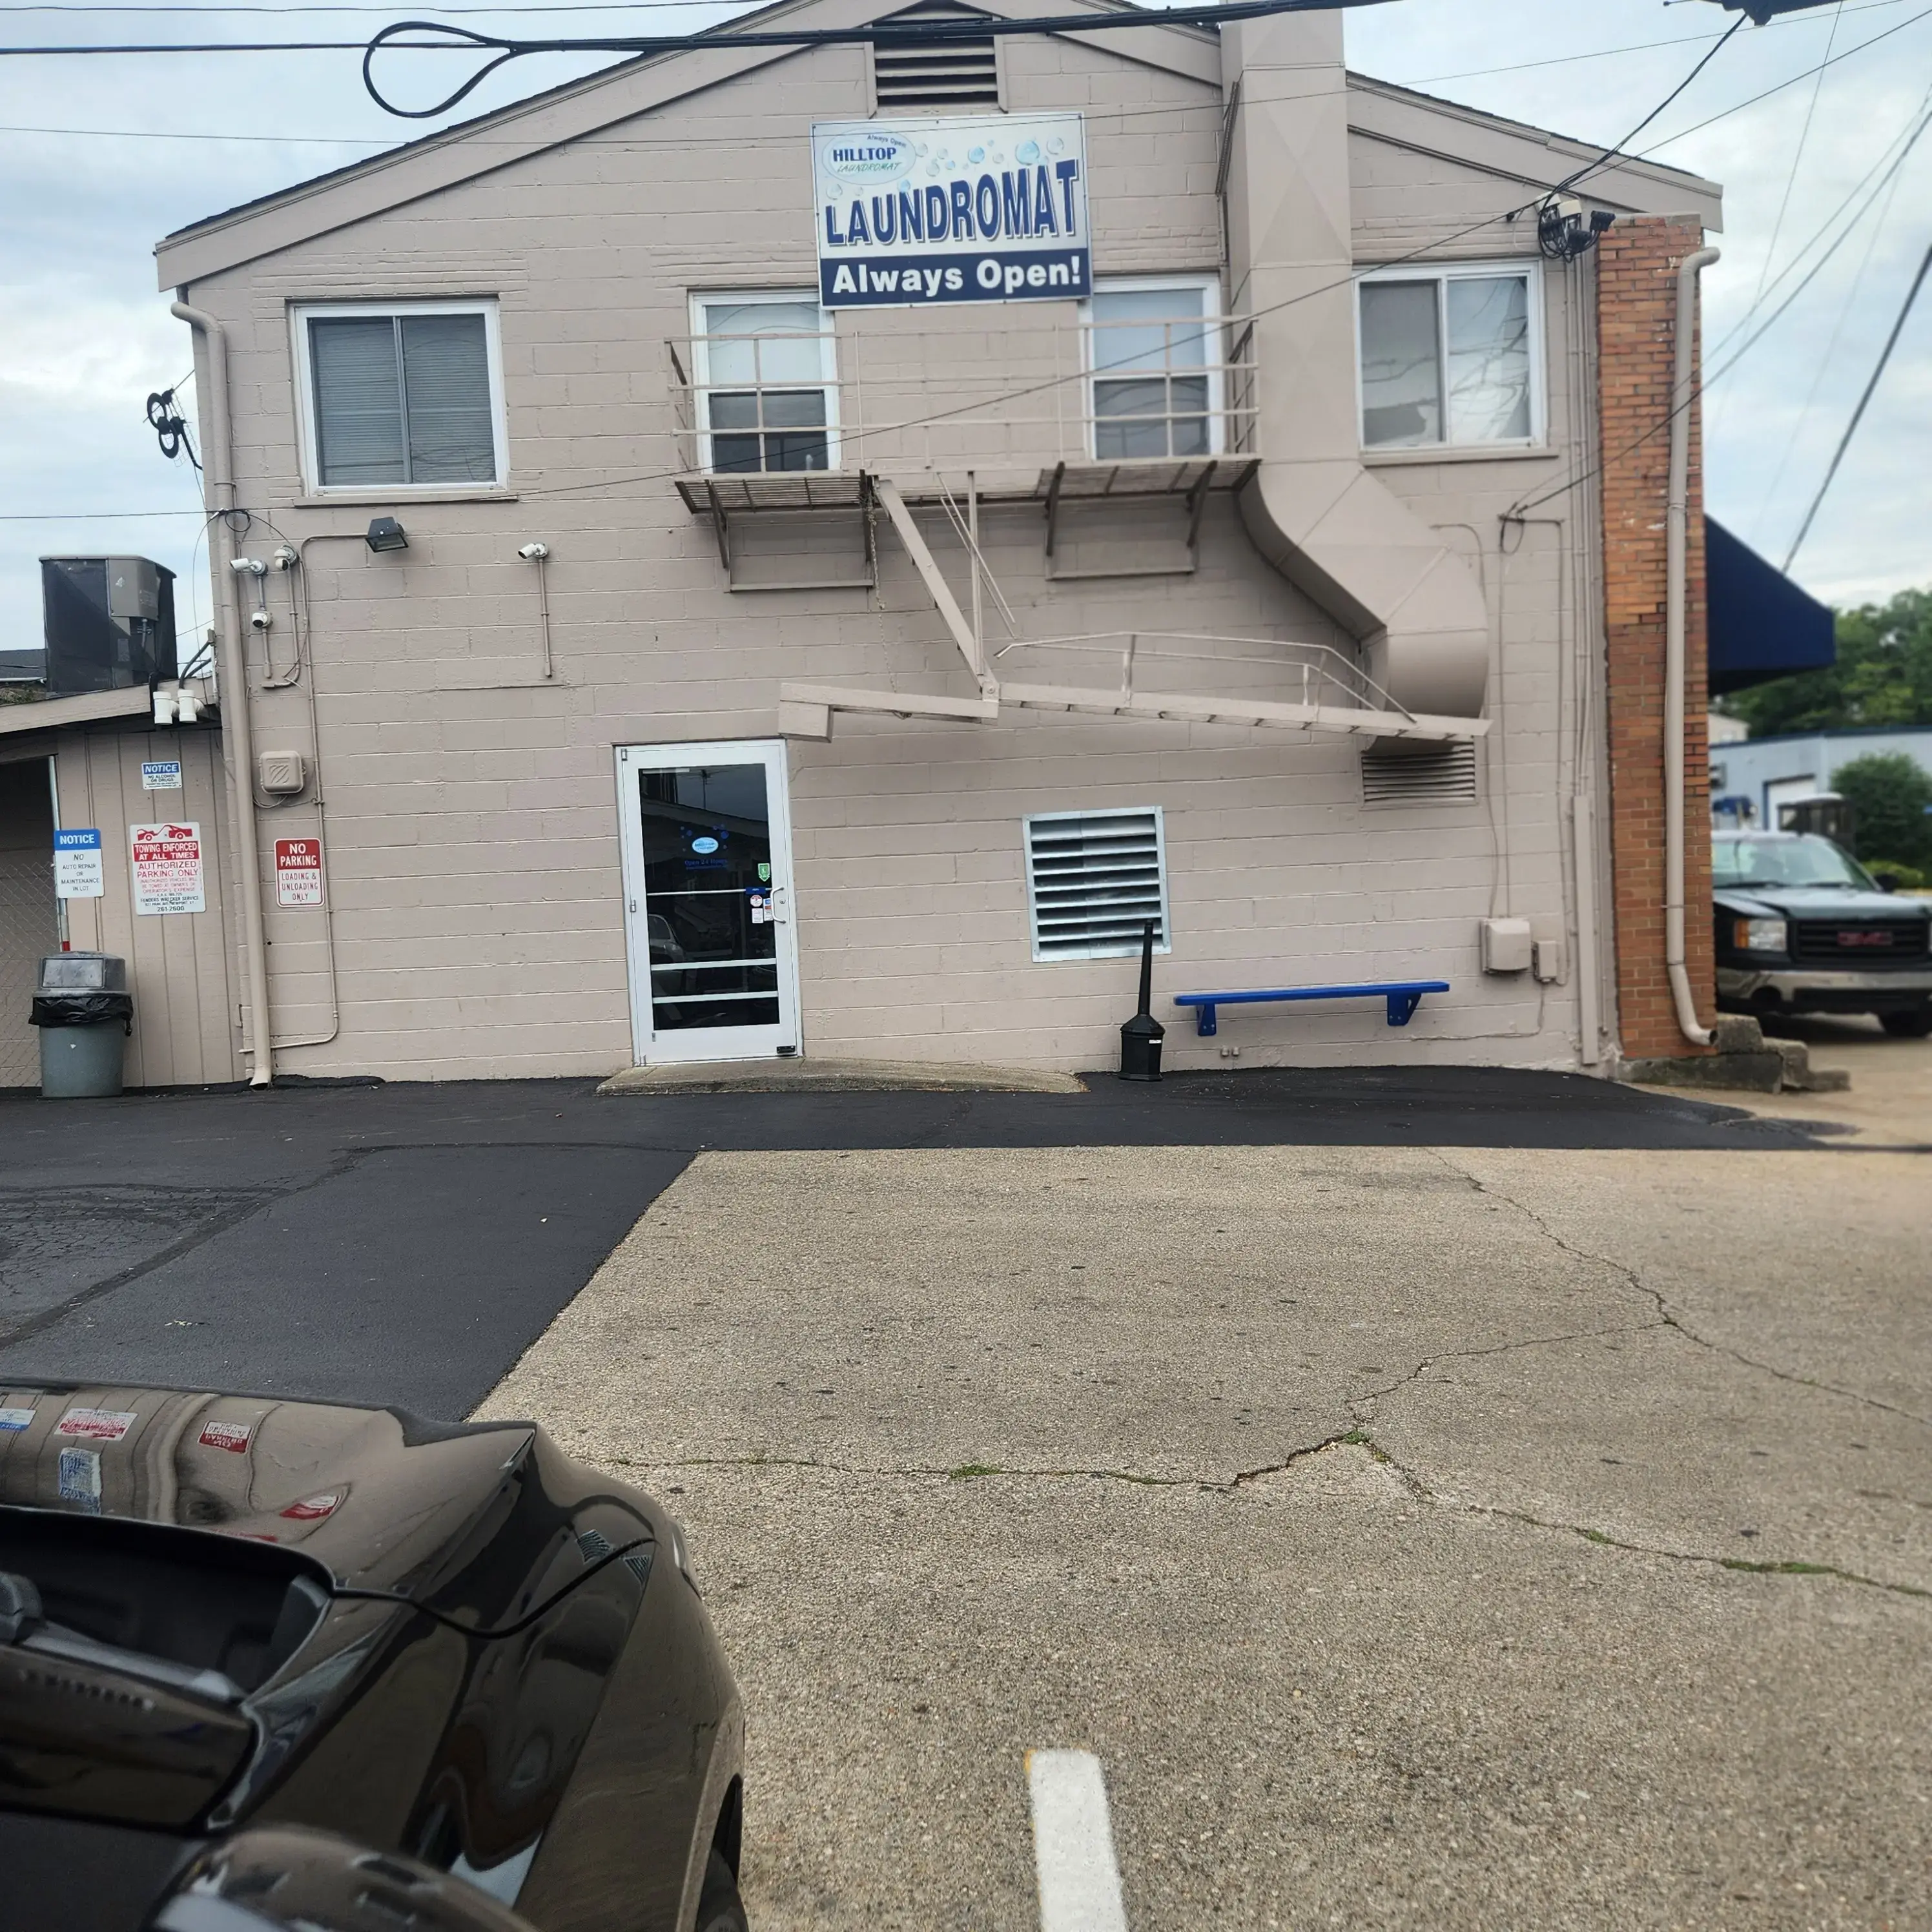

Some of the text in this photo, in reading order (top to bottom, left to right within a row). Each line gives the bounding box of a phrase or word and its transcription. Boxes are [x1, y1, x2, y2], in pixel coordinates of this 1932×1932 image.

[867, 134, 889, 143] Always
[833, 147, 896, 161] HILLTOP
[838, 162, 903, 172] LAUNDROMAT
[825, 158, 1079, 247] LAUNDROMAT
[832, 256, 1082, 297] Always Open!
[145, 764, 177, 773] NOTICE
[59, 834, 95, 845] NOTICE
[134, 842, 198, 853] TOWING ENFORCED
[289, 843, 306, 854] NO
[138, 861, 196, 870] AUTHORIZED
[280, 855, 317, 867] PARKING
[137, 870, 174, 878] PARKING
[282, 872, 309, 881] LOADING
[292, 892, 309, 901] ONLY
